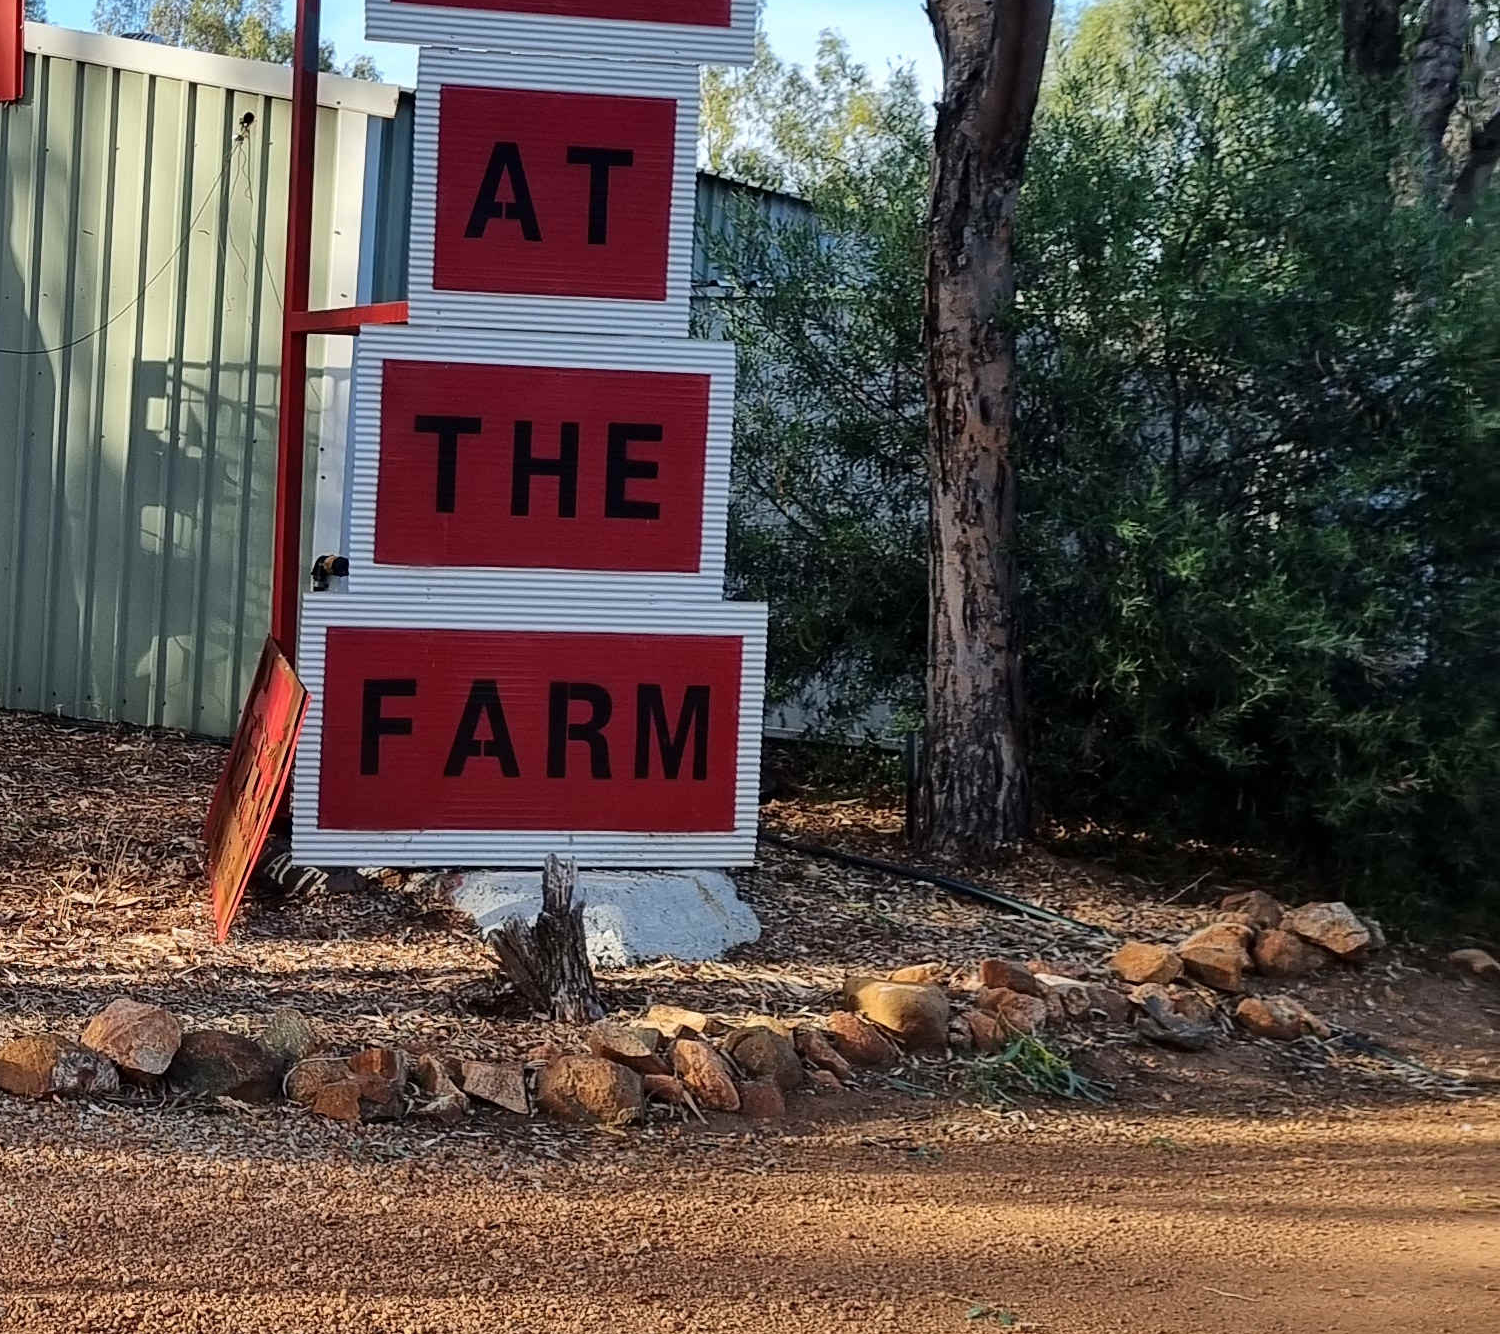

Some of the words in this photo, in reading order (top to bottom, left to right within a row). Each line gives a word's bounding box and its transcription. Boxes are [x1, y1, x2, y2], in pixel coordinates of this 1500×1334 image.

[463, 141, 634, 246] AT
[414, 414, 663, 519] THE
[359, 677, 711, 782] FARM
